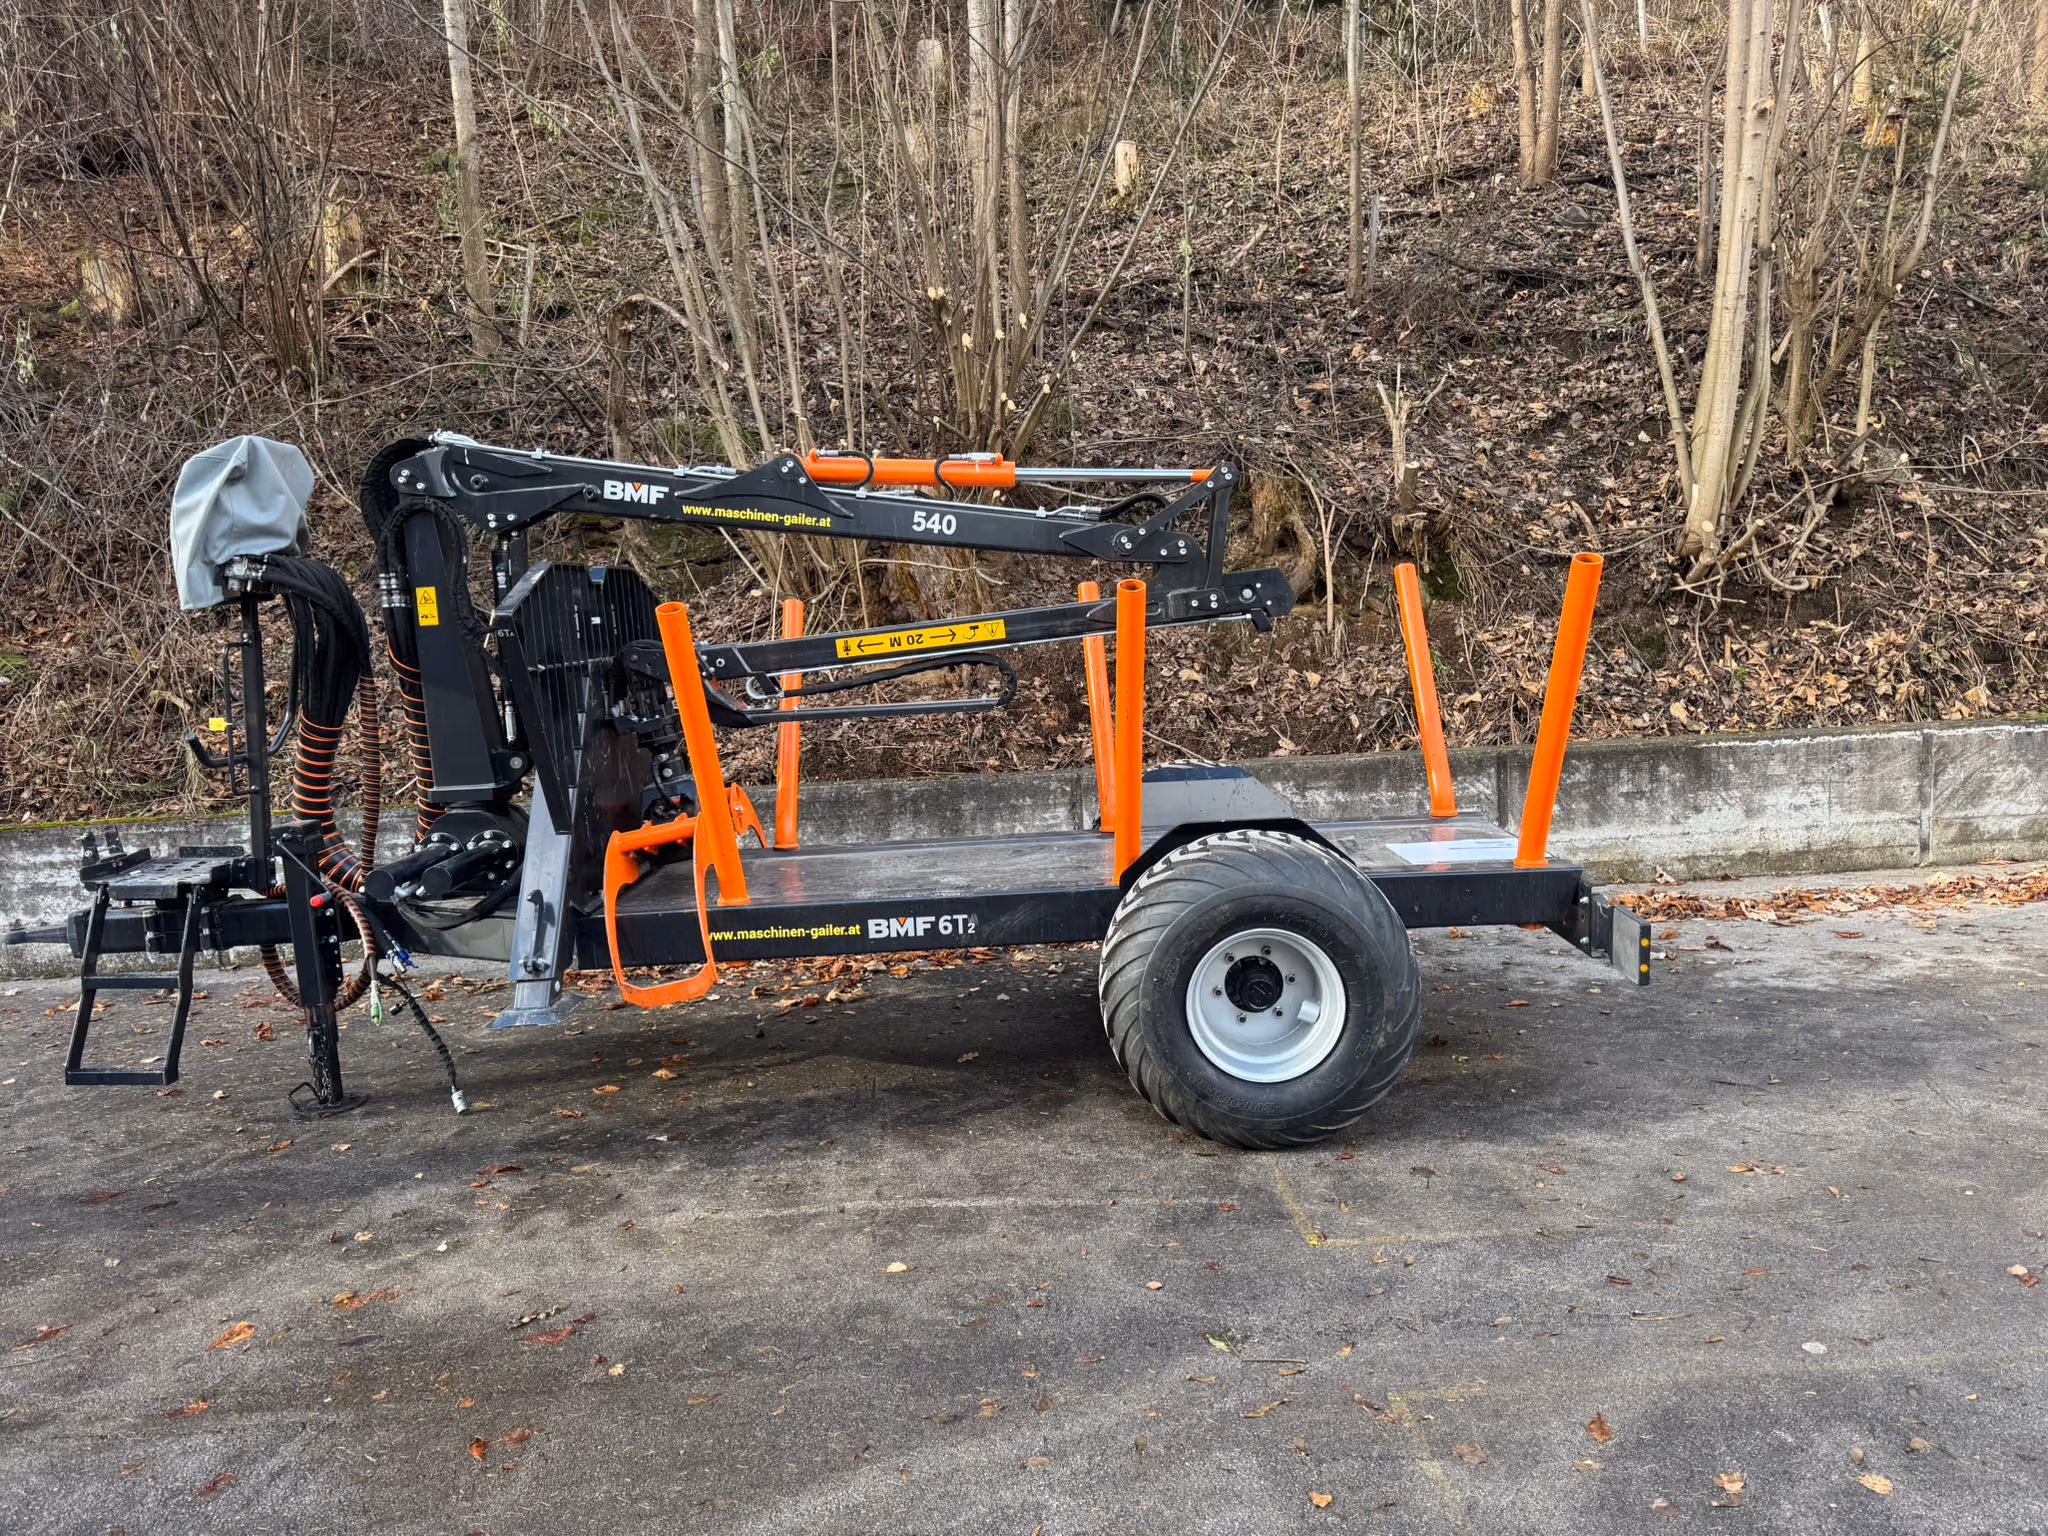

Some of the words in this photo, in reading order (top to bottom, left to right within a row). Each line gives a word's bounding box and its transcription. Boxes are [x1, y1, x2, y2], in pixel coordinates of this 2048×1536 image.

[603, 480, 669, 504] BMF
[682, 504, 831, 527] www.maschinen-gailer.at
[911, 511, 957, 536] 540
[890, 637, 901, 647] M
[907, 634, 923, 645] 20
[710, 924, 861, 940] ww.maschinen-gailer.at
[867, 916, 935, 939] BMF
